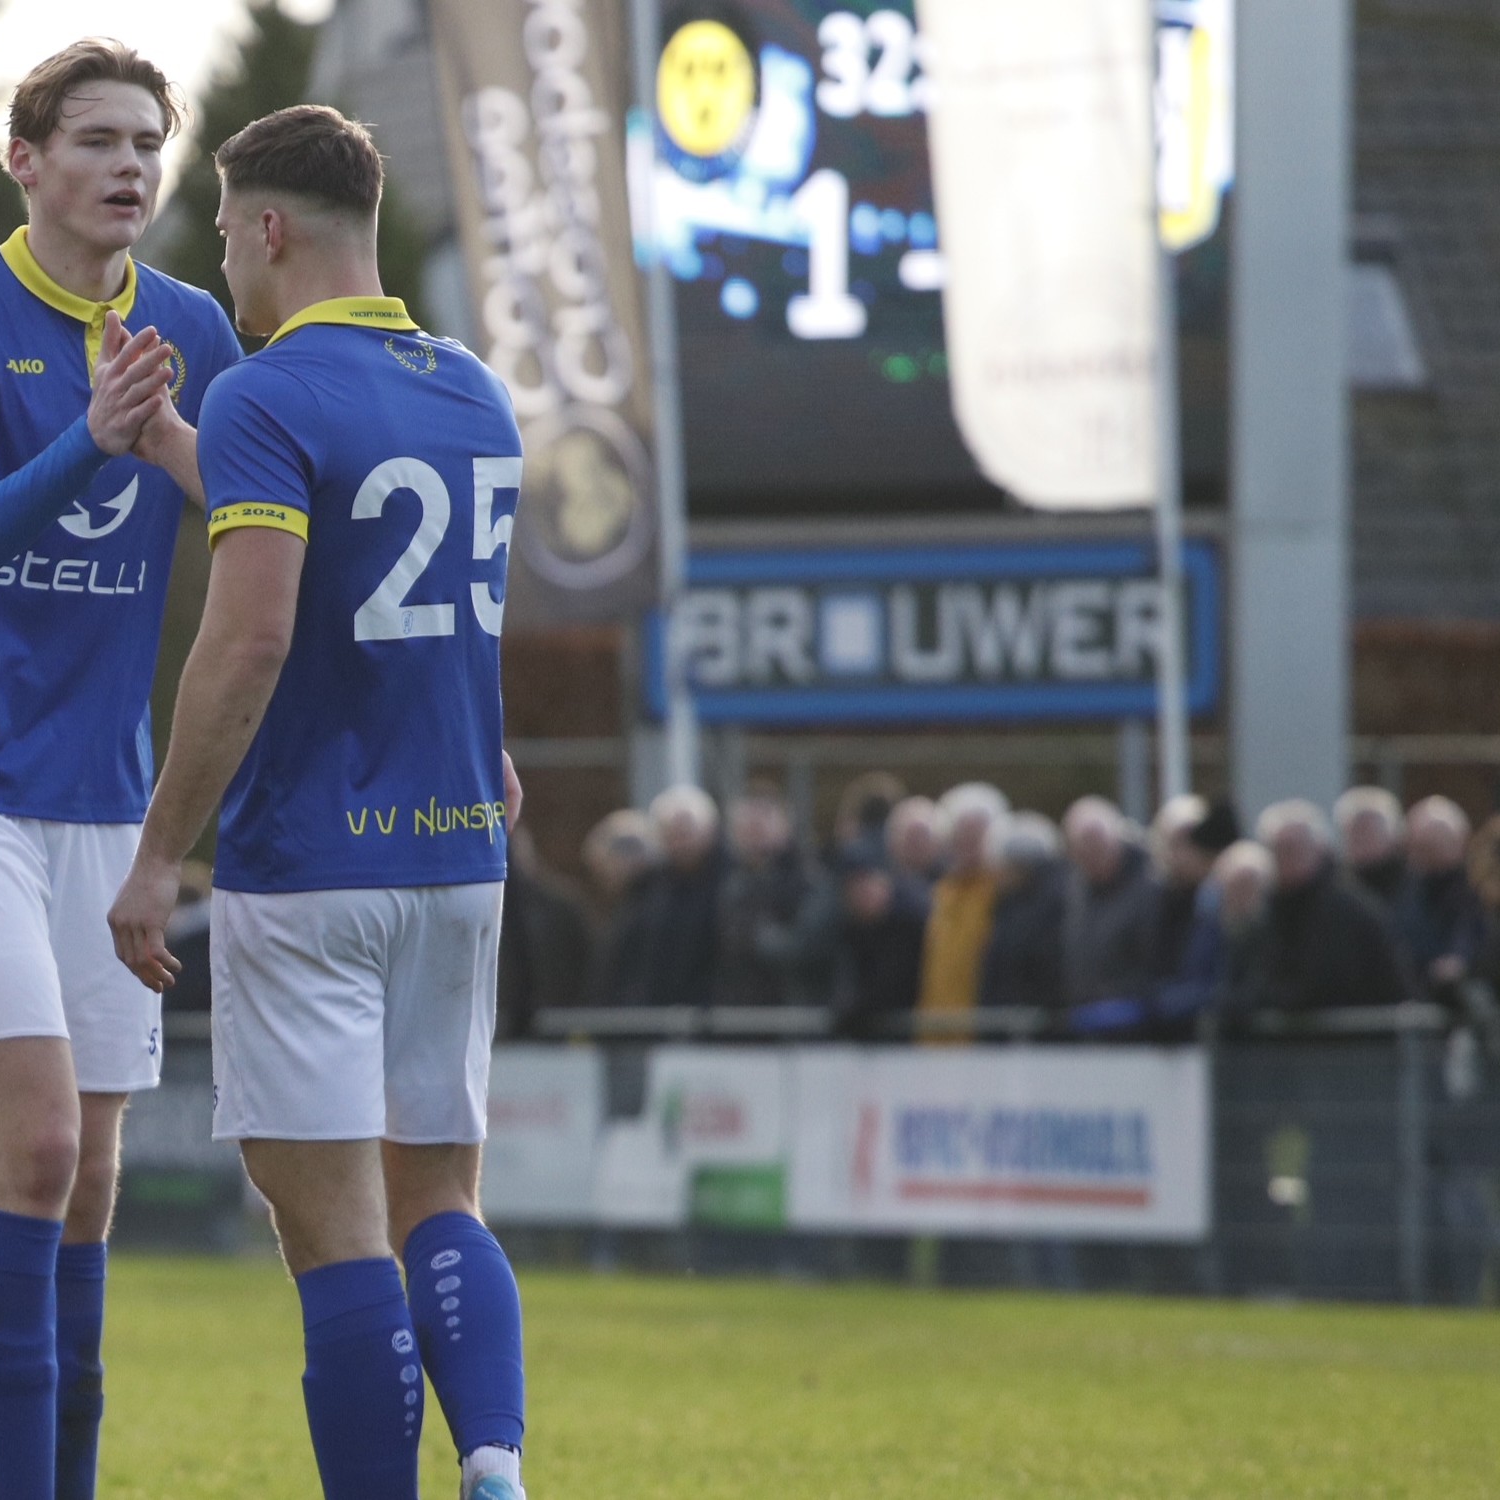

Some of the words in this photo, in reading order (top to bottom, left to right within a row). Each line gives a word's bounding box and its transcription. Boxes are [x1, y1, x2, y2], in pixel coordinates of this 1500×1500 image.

[786, 168, 867, 340] 1
[241, 507, 287, 521] 2024
[350, 456, 523, 642] 25
